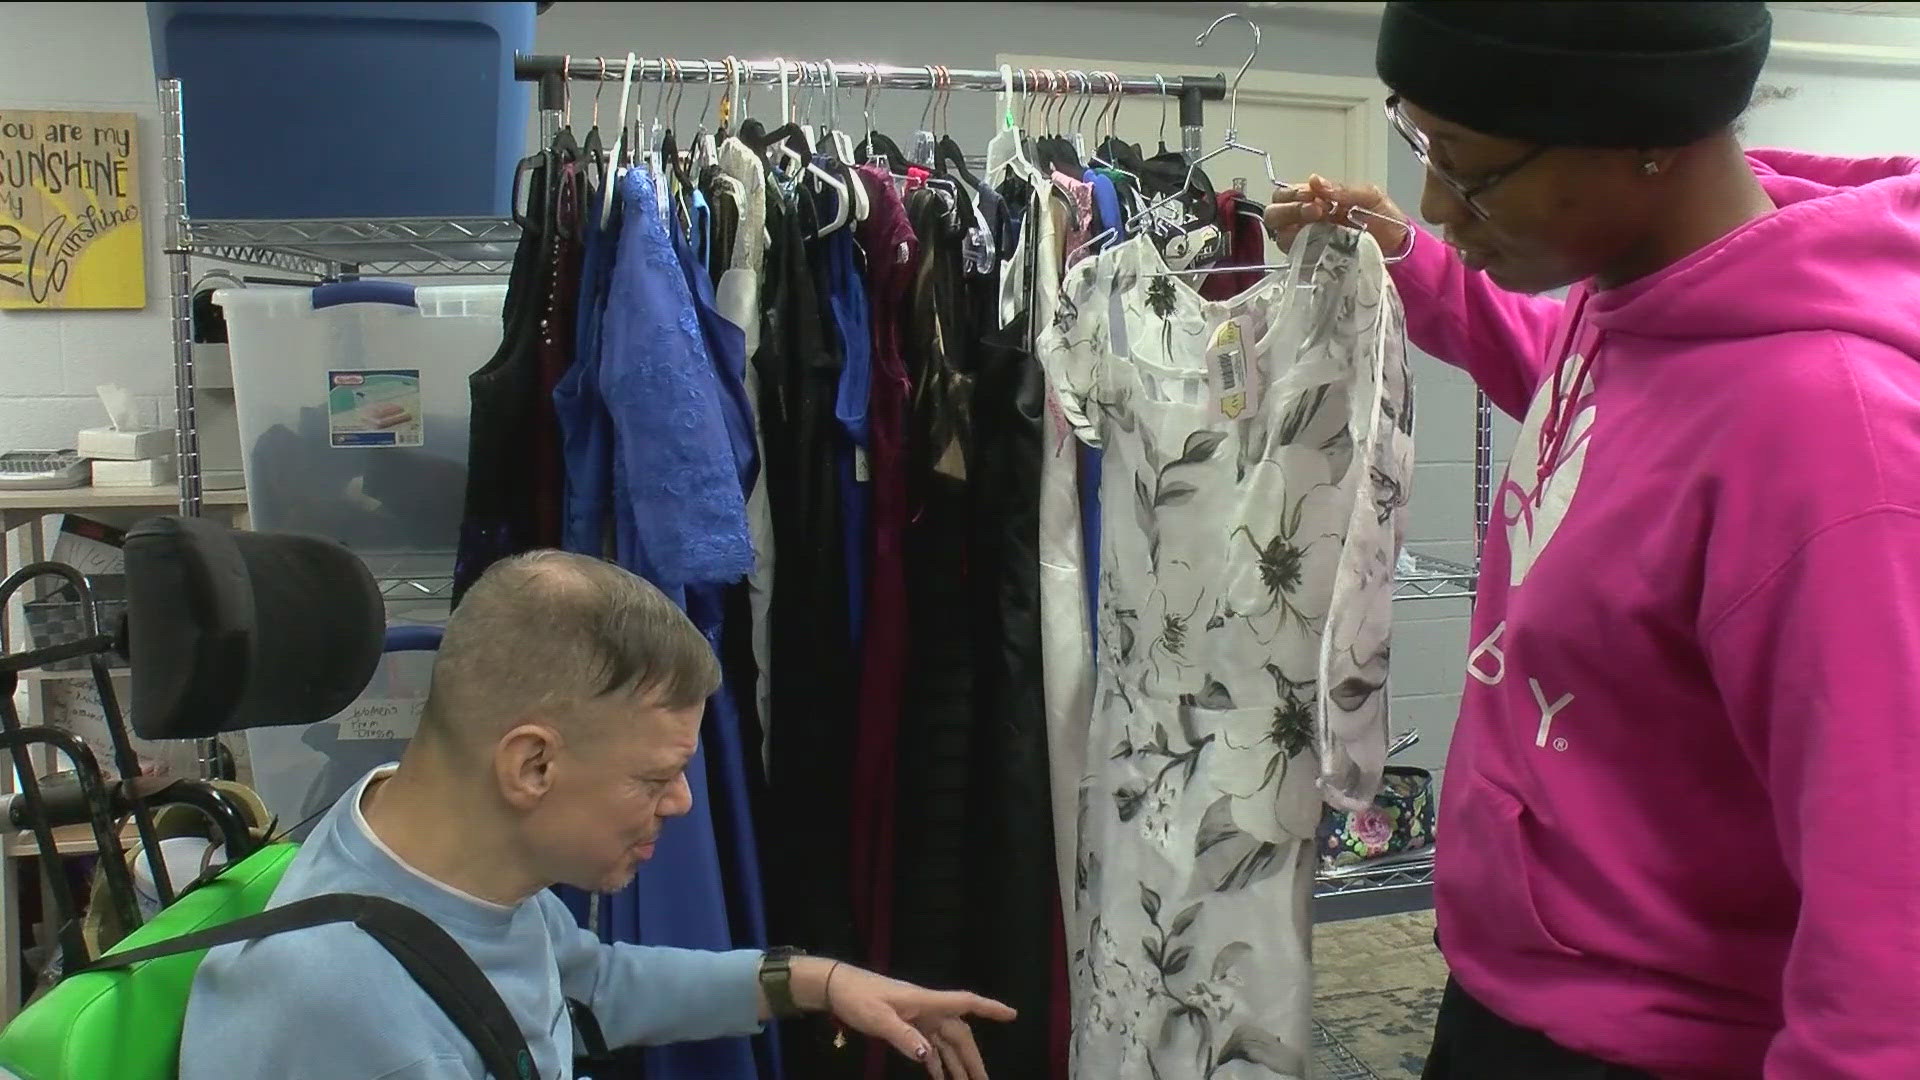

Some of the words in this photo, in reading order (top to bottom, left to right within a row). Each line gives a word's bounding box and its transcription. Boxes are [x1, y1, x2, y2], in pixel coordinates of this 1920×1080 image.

[0, 115, 34, 140] ou
[45, 123, 83, 143] are
[94, 126, 131, 158] my
